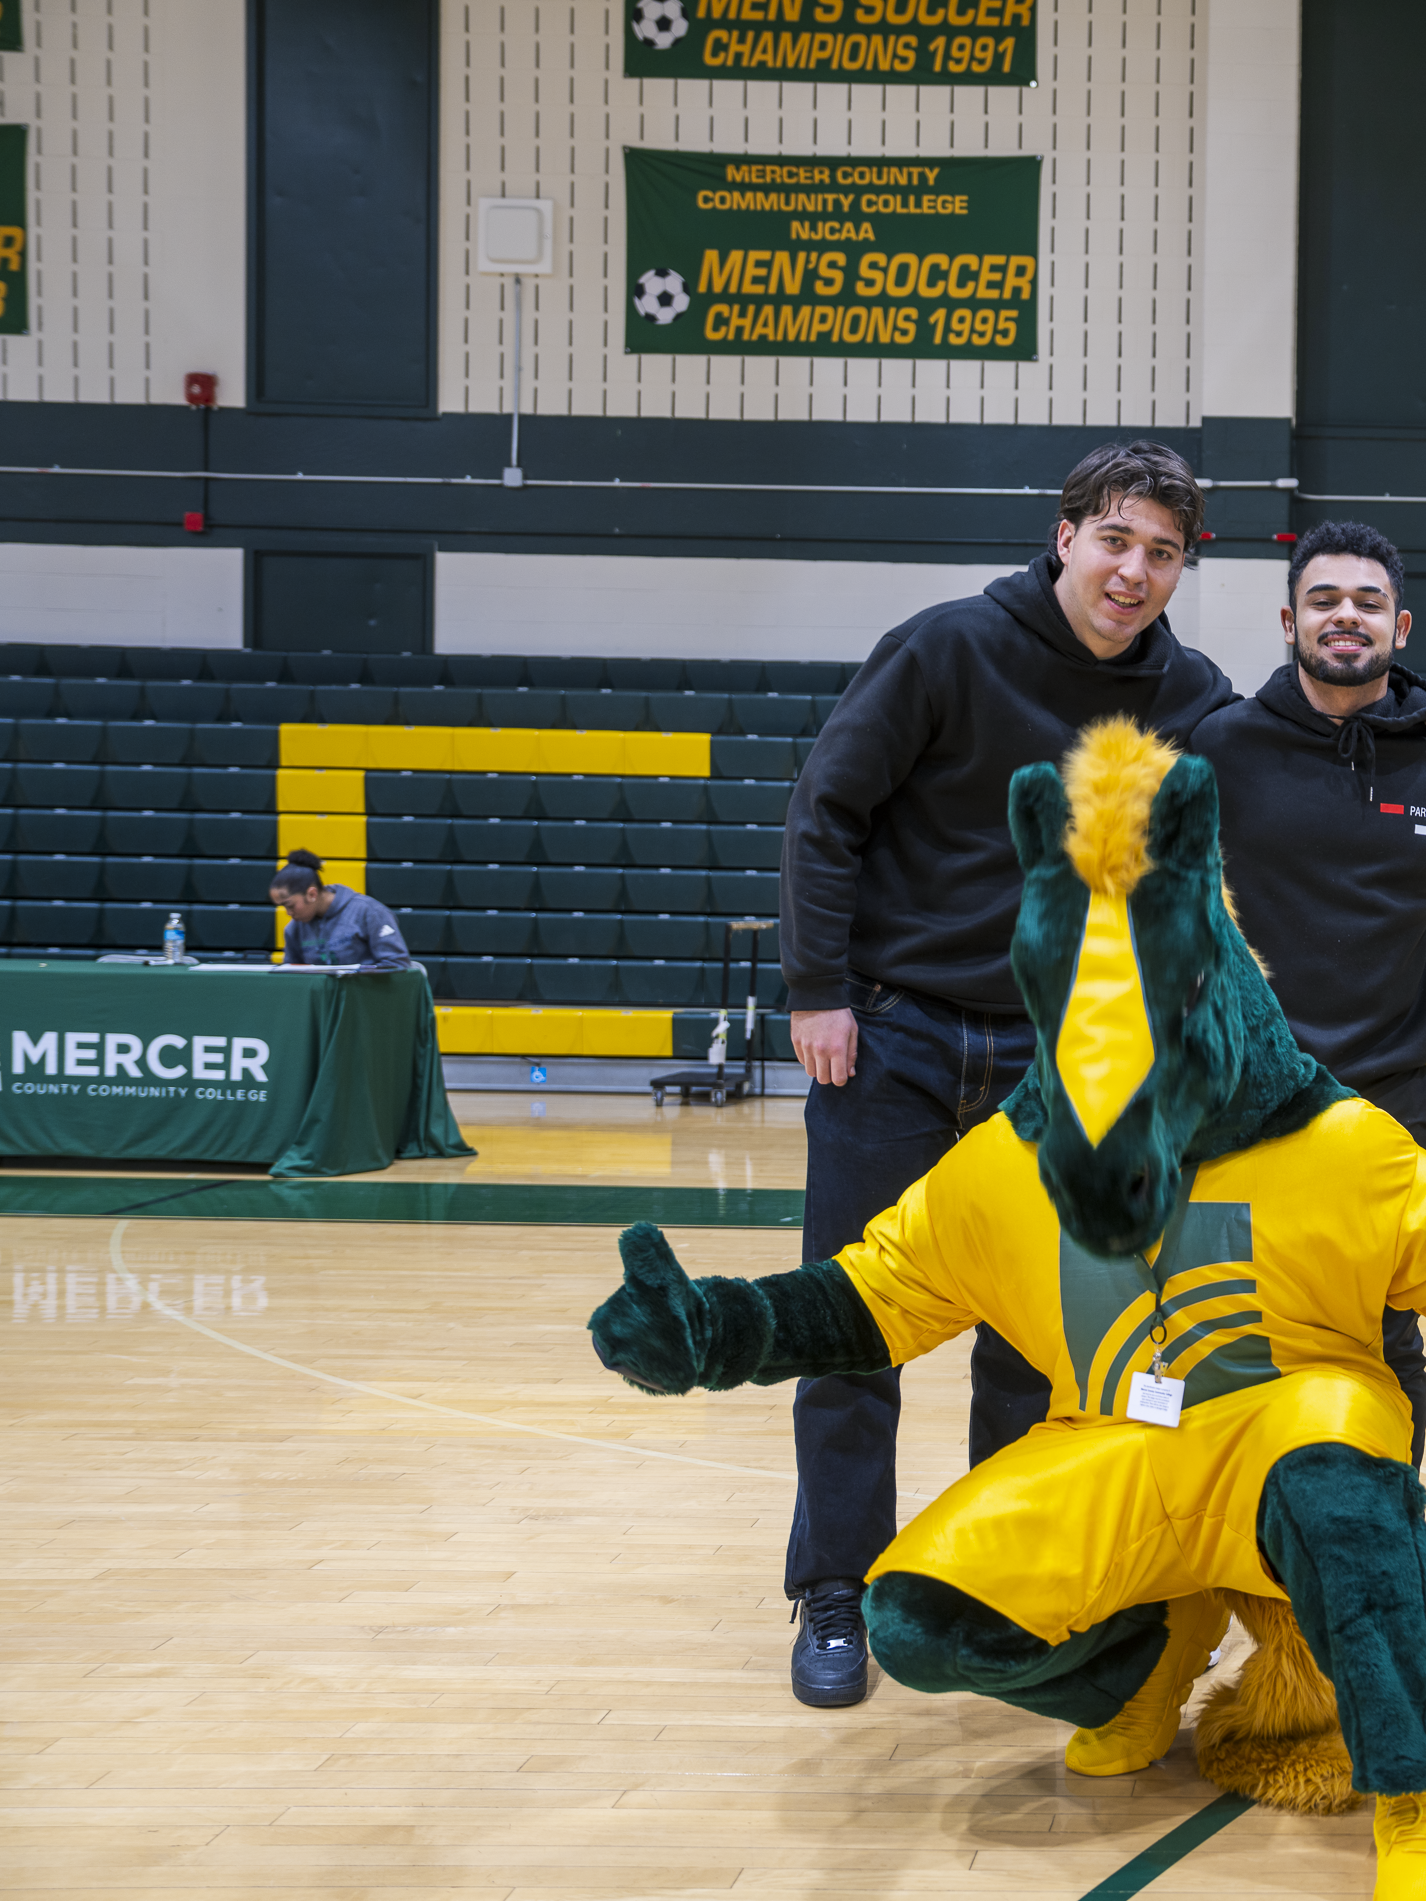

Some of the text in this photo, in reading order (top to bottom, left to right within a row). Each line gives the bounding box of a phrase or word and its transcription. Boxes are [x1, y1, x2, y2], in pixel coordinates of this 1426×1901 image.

[855, 0, 1034, 27] SOCCER
[703, 29, 1016, 73] CHAMPIONS 1991
[726, 164, 940, 187] MERCER COUNTY
[696, 189, 969, 215] COMMUNITY COLLEGE
[790, 220, 876, 242] NJCAA
[697, 248, 1036, 300] MEN'S SOCCER
[704, 303, 1019, 347] CHAMPIONS 1995
[11, 1030, 270, 1083] MERCER
[11, 1082, 269, 1103] COUNTY COMMUNITY COLLEGE
